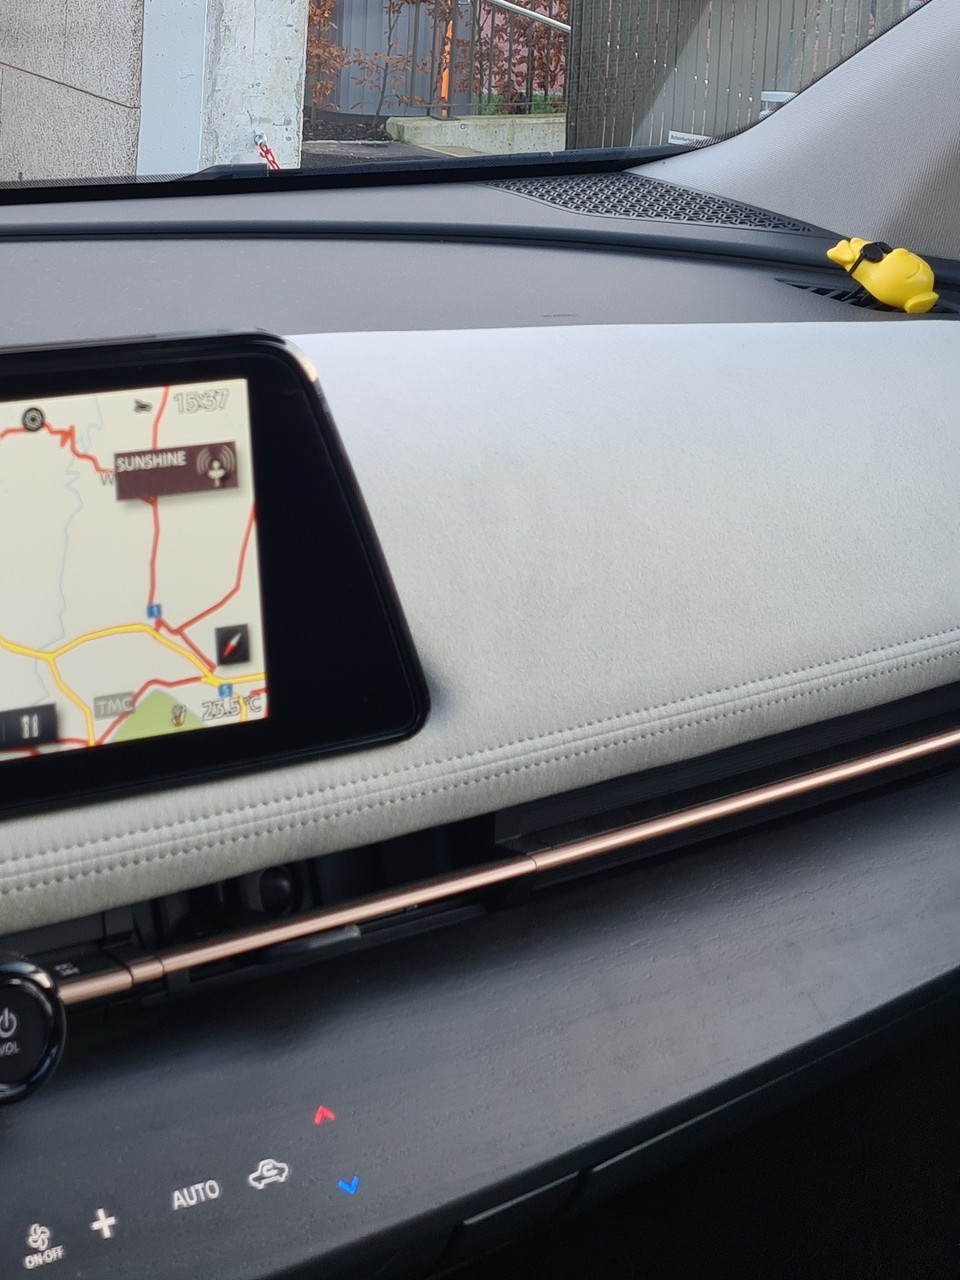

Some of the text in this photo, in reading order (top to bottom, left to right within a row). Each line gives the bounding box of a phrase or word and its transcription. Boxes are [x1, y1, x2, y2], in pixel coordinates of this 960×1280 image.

[174, 389, 228, 414] 15:37
[116, 450, 187, 472] SUNSHINE
[97, 698, 134, 714] TMC
[173, 1180, 220, 1211] AUTO
